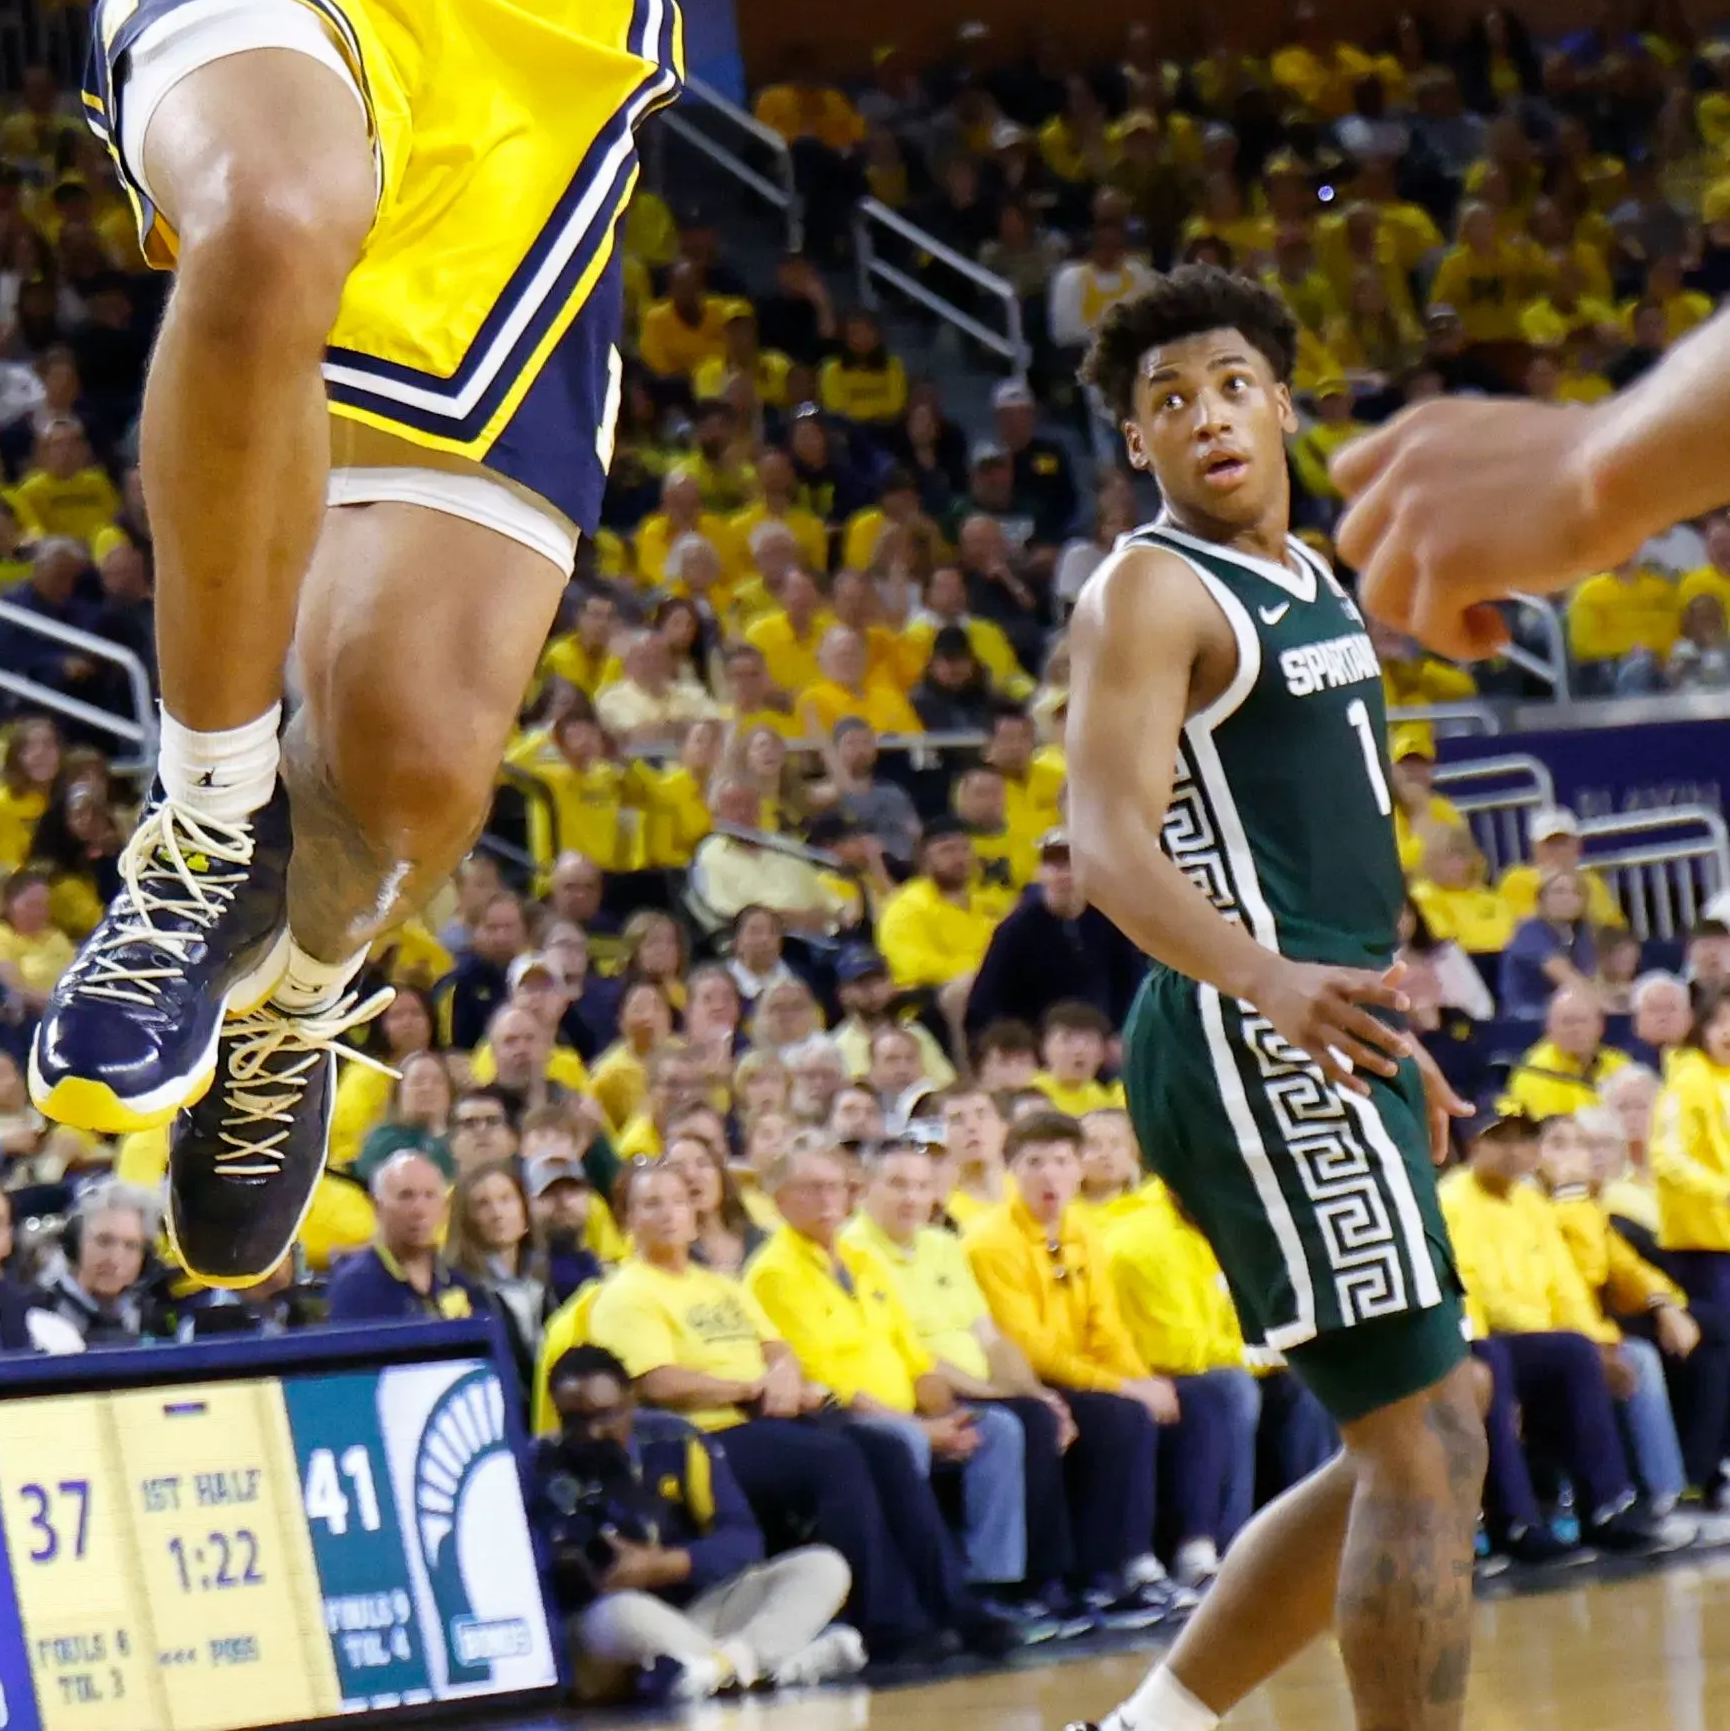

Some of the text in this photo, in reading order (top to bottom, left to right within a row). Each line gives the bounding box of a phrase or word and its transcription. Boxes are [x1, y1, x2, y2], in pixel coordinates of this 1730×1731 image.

[1347, 698, 1391, 816] 1
[18, 1478, 92, 1564] 37
[140, 1467, 262, 1516] 1ST HALF
[304, 1443, 382, 1536] 41
[167, 1529, 267, 1593] 1:22
